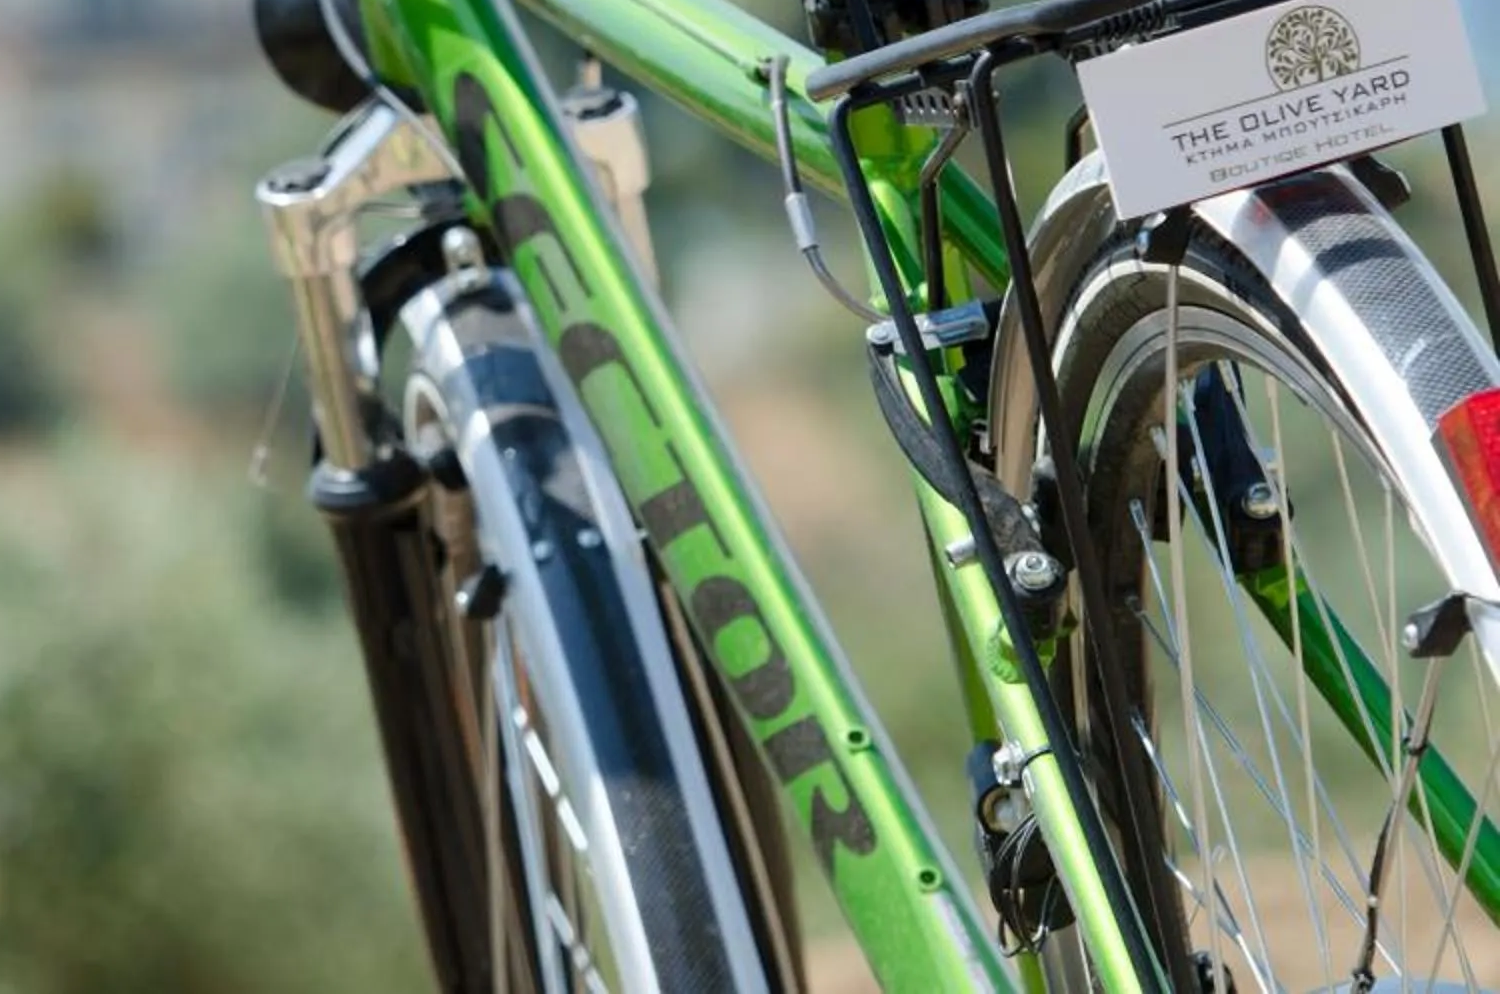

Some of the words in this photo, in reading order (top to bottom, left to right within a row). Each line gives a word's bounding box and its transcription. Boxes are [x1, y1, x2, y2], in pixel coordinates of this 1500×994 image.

[1171, 120, 1230, 151] THE
[1238, 93, 1324, 133] OLIVE
[1331, 69, 1410, 104] YARD
